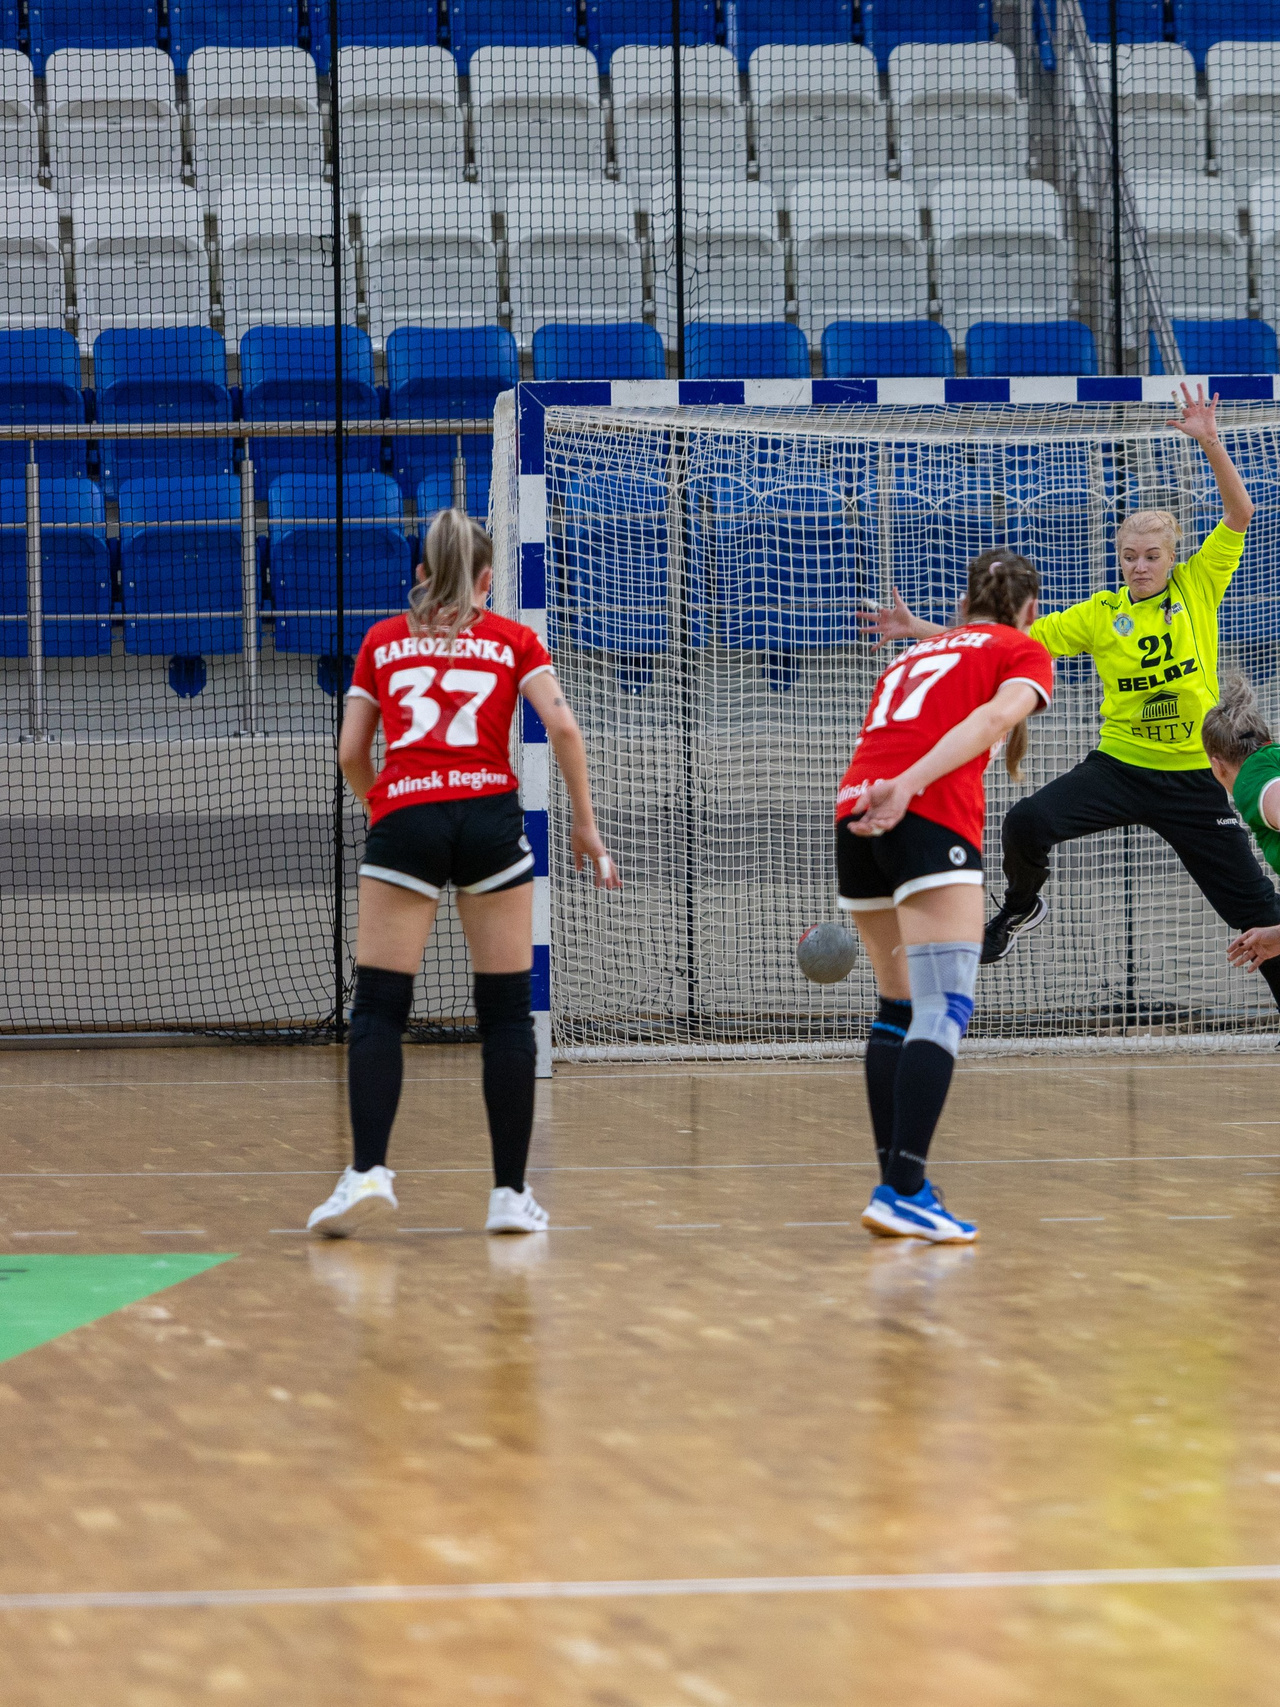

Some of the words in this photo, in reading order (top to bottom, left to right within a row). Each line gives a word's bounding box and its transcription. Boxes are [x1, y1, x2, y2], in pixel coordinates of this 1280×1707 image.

[1137, 632, 1175, 668] 21
[866, 653, 961, 732] 17
[1117, 658, 1198, 692] BELAZ
[387, 666, 497, 750] 37
[386, 770, 444, 799] Minsk
[448, 768, 508, 791] Region
